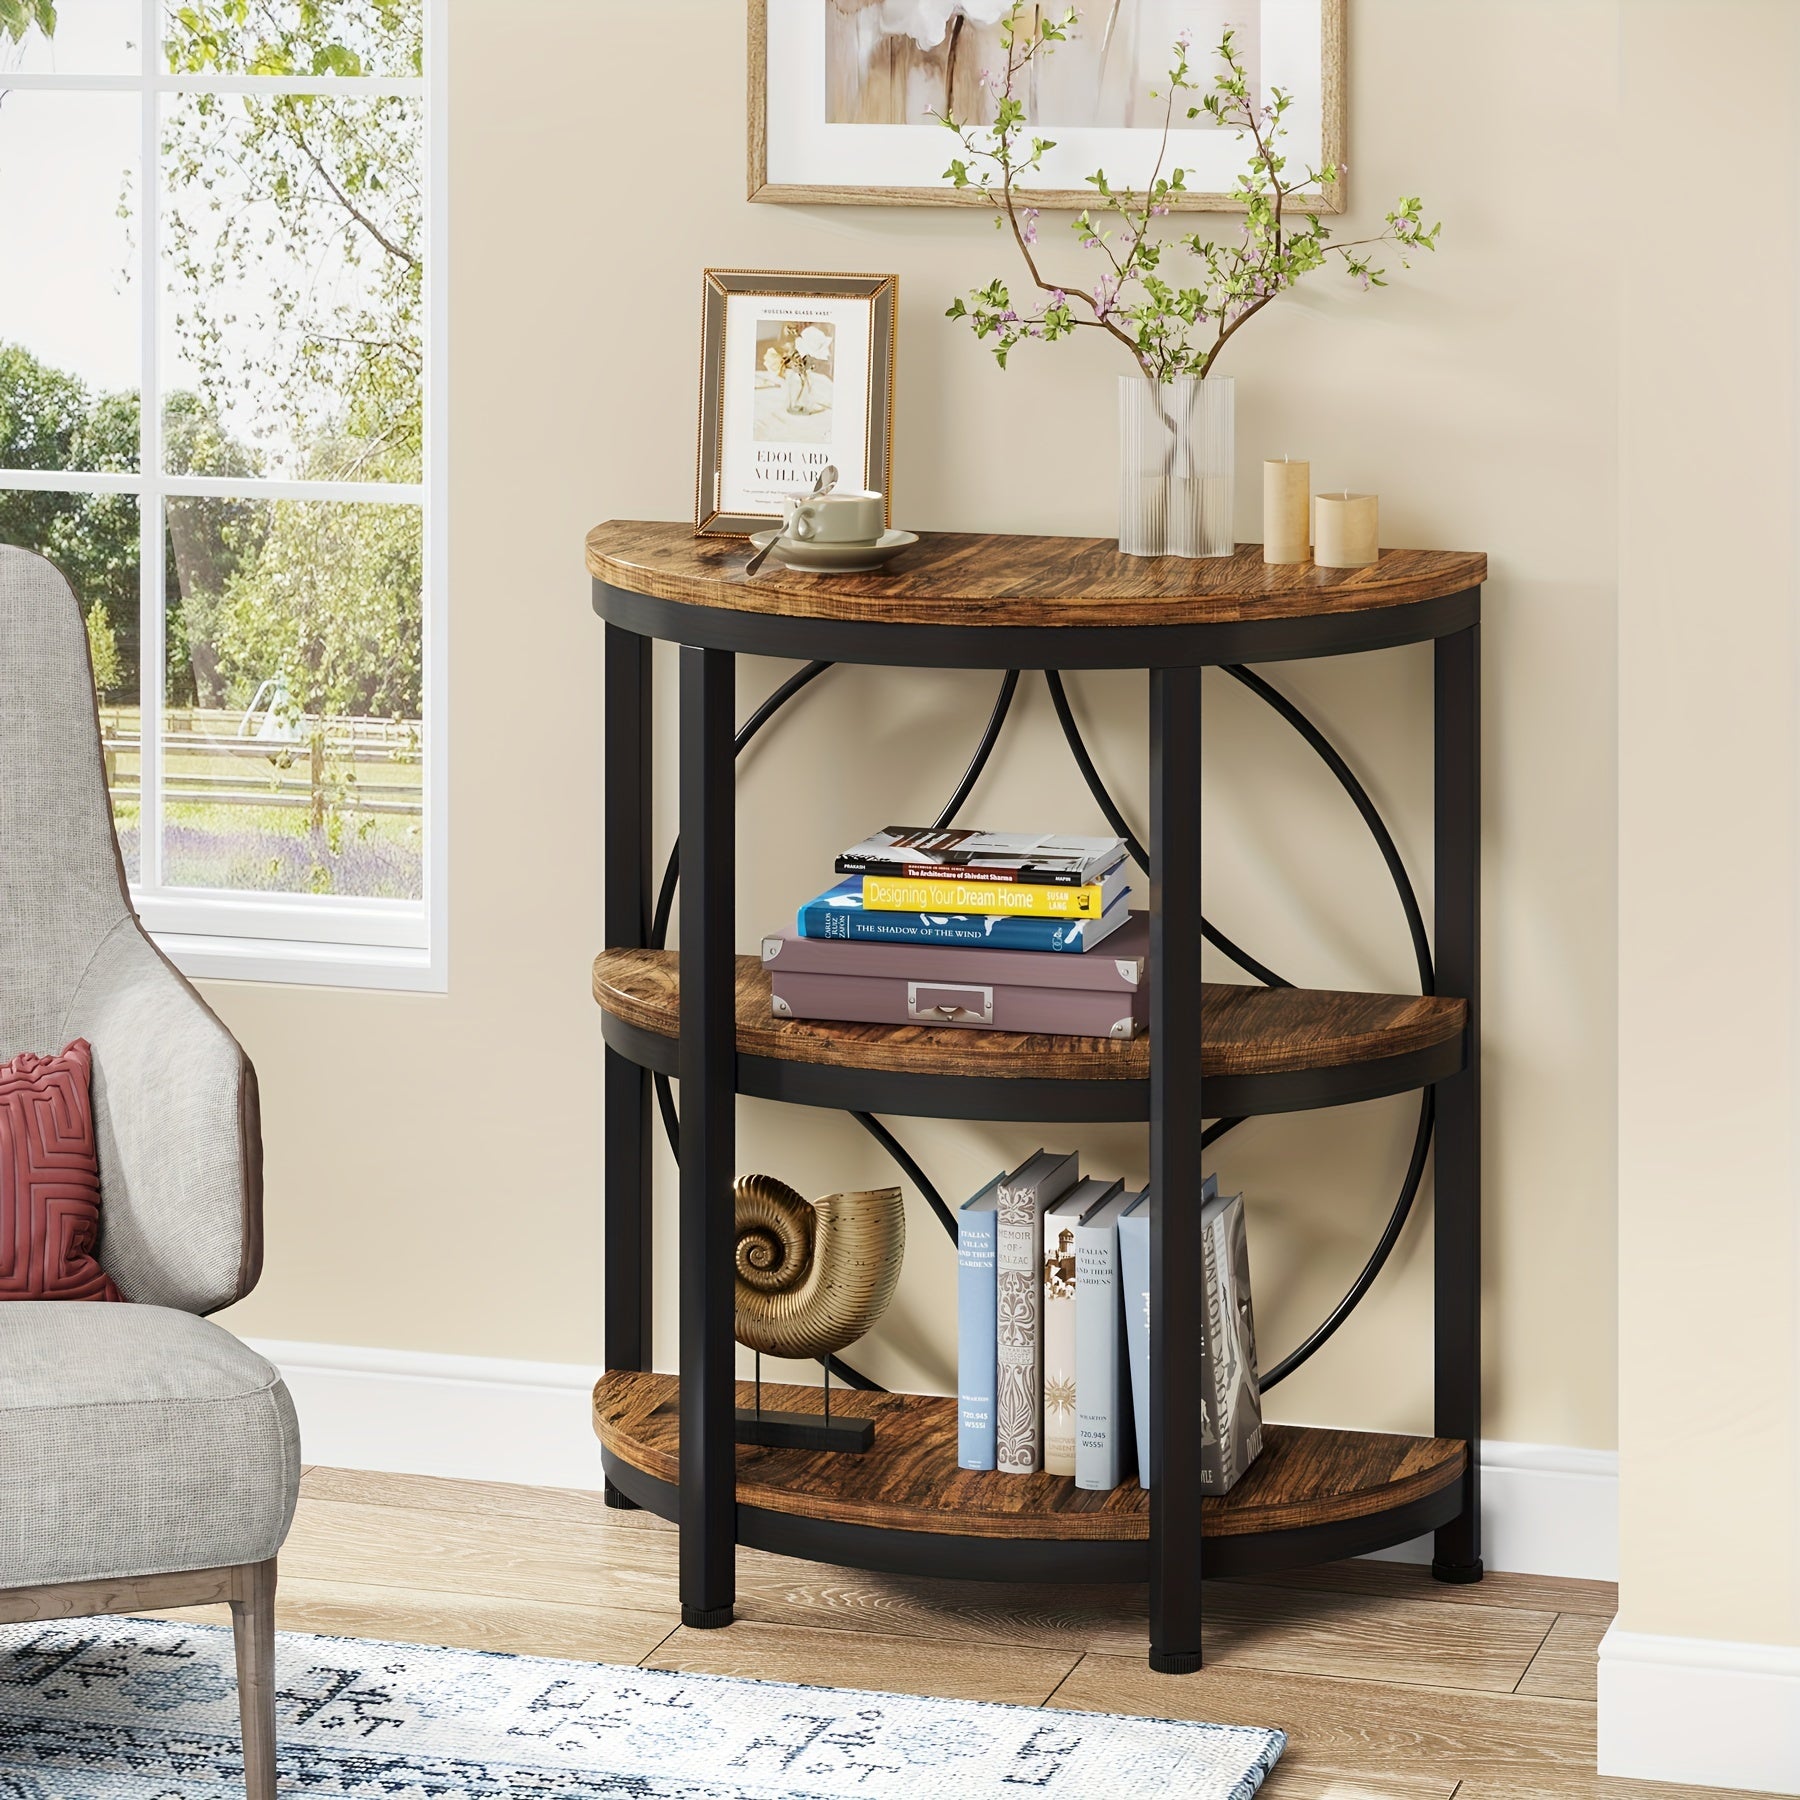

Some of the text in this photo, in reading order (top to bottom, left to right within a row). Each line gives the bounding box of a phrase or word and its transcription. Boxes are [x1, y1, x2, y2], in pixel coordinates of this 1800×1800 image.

[757, 450, 829, 465] EDOUARD
[755, 467, 822, 482] VUILLAR
[920, 870, 956, 879] Architecture
[963, 873, 990, 881] Shivdatt
[989, 874, 1013, 882] Sharma
[870, 882, 1034, 908] Designing Your Dream Home
[1046, 891, 1069, 901] SUSAN
[1049, 901, 1067, 911] LANG
[824, 912, 832, 939] CARLOS
[831, 917, 839, 935] RUIZ
[856, 924, 876, 933] THE
[877, 925, 918, 935] SHADOW
[920, 928, 934, 936] OF
[954, 931, 982, 939] WIND
[960, 1230, 991, 1239] ITALIAN
[962, 1240, 989, 1249] VILLAS
[1078, 1247, 1108, 1255] ITALIAN
[959, 1260, 993, 1268] GARDENS
[1080, 1257, 1107, 1265] VILLAS
[963, 1410, 989, 1420] 720.945
[1080, 1430, 1106, 1439] 720.945
